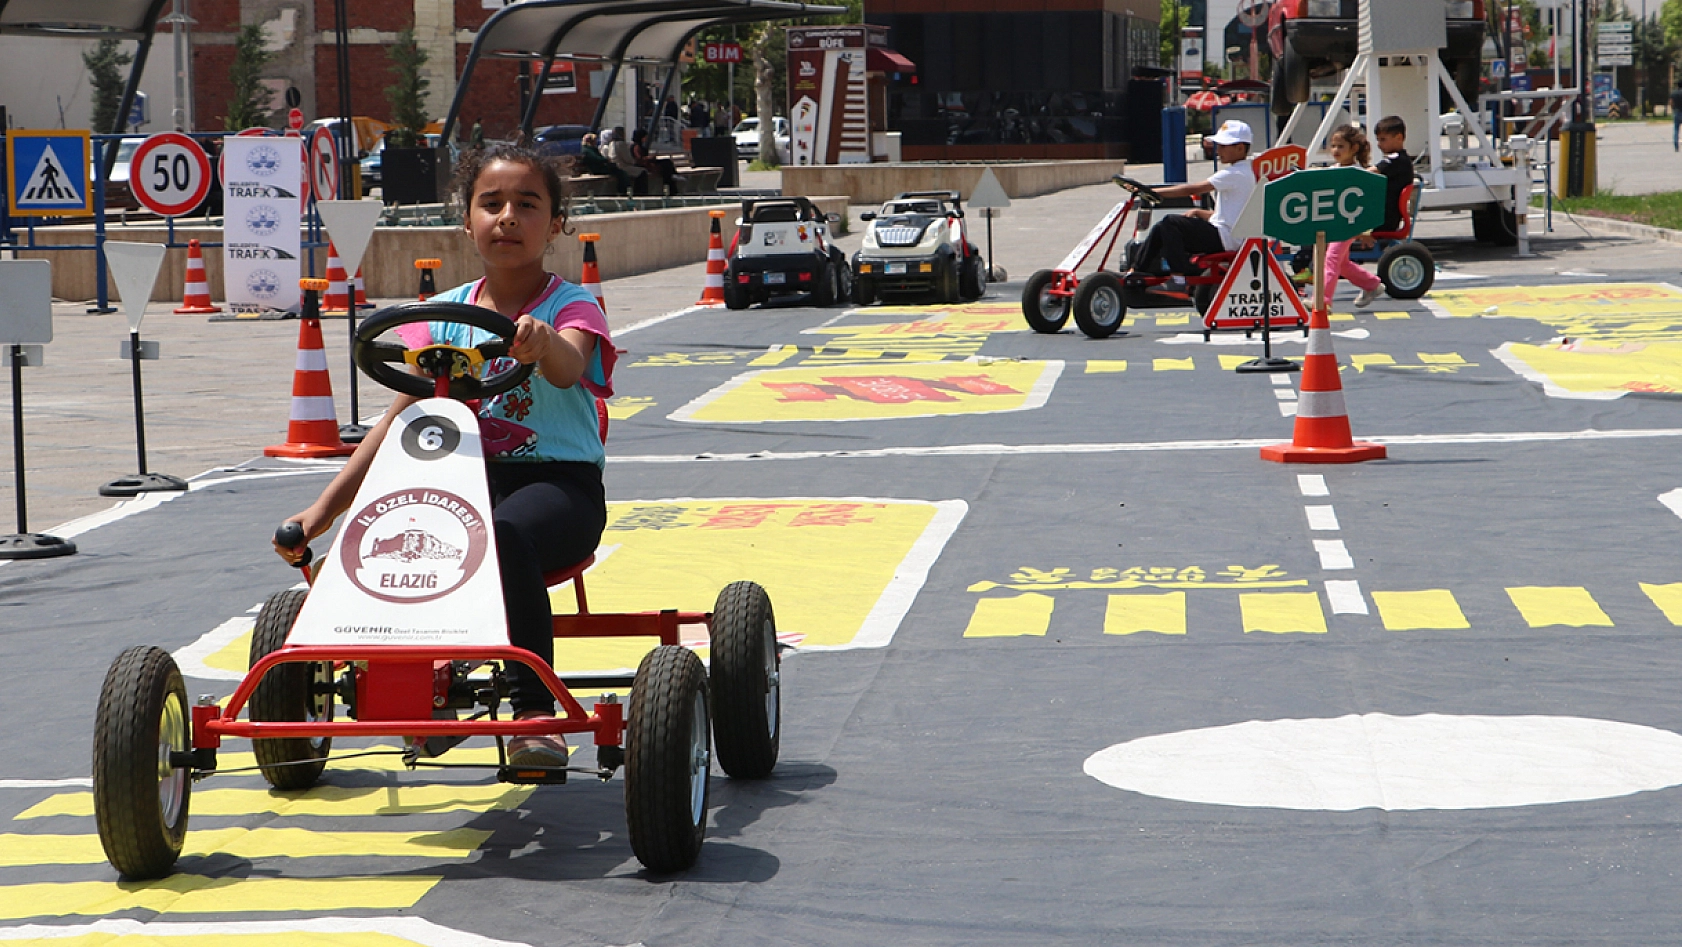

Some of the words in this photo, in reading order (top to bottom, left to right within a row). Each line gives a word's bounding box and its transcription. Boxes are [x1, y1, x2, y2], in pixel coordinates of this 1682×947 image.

[706, 44, 740, 59] BİM
[819, 36, 845, 48] BÜFE
[153, 152, 190, 192] 50
[1260, 152, 1300, 178] DUR
[1279, 186, 1364, 225] GEÇ
[418, 425, 443, 451] 6
[357, 514, 377, 527] İL
[375, 493, 419, 513] ÖZEL
[422, 490, 482, 527] İDARESİ
[379, 569, 439, 588] ELAZIĞ
[333, 624, 393, 635] GÜVENİR
